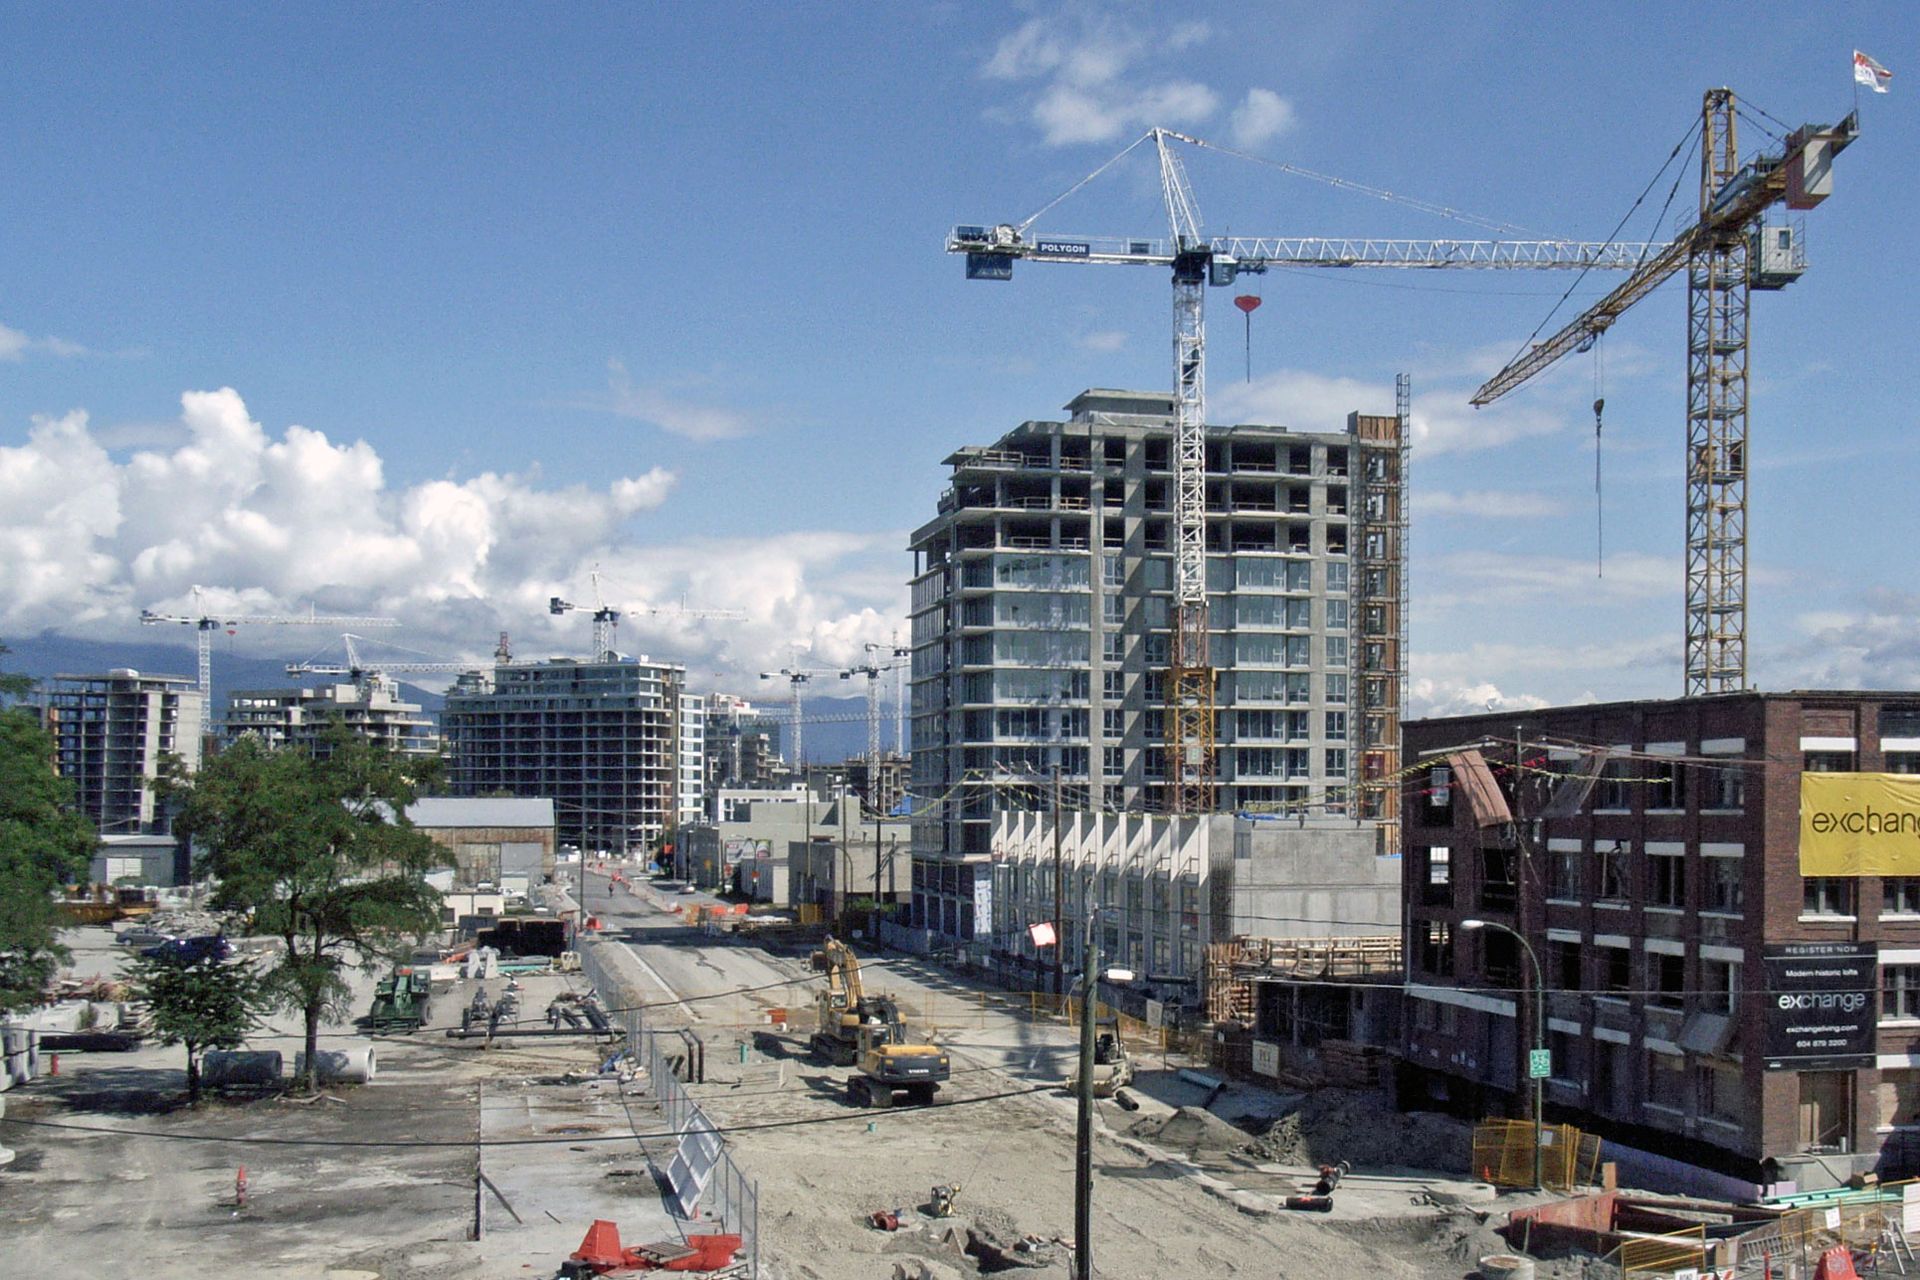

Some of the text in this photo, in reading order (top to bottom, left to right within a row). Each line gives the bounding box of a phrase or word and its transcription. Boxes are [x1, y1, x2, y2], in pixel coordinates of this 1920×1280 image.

[1041, 244, 1086, 253] POLYGON
[1812, 805, 1920, 840] exchan
[1784, 946, 1833, 954] REGISTER
[1778, 993, 1866, 1012] exchange
[1796, 1040, 1811, 1048] 604
